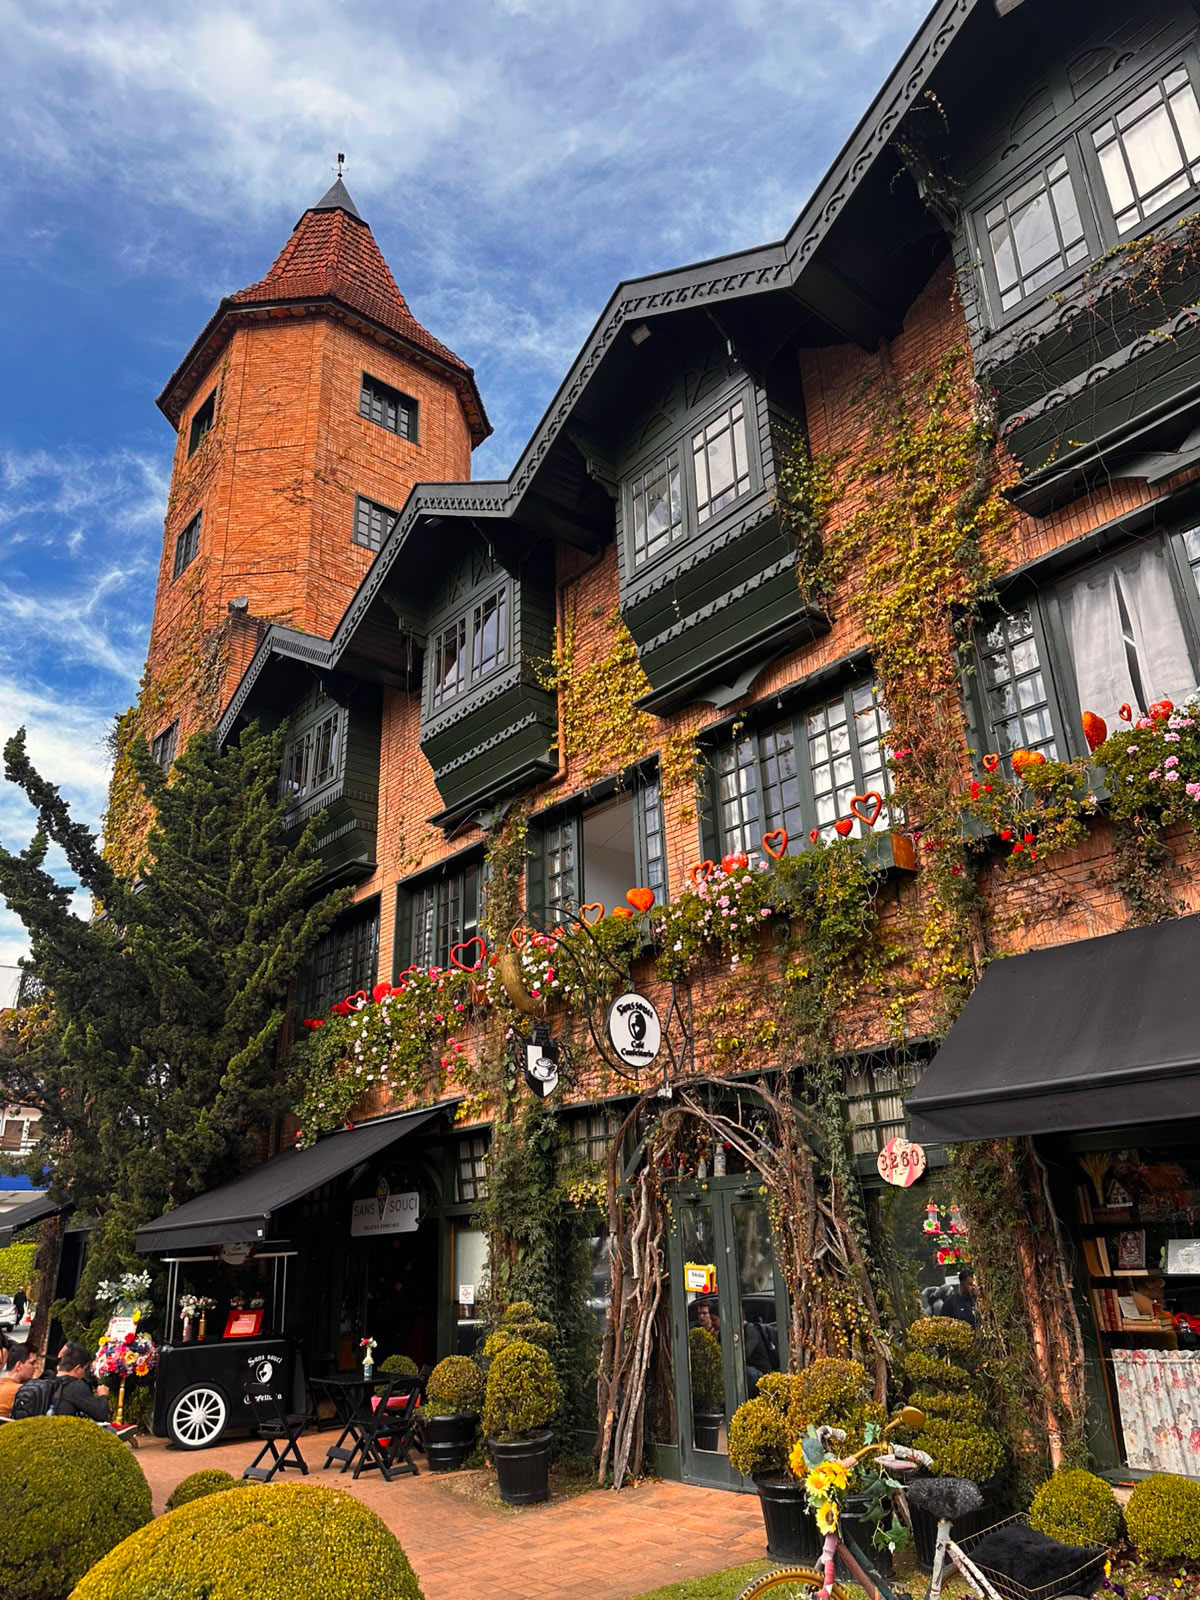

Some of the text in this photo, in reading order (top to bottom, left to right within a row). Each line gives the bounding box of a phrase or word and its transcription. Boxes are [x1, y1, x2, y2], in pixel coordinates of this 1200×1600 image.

[354, 1197, 418, 1217] SANS SOUCI
[247, 1355, 265, 1367] Sans
